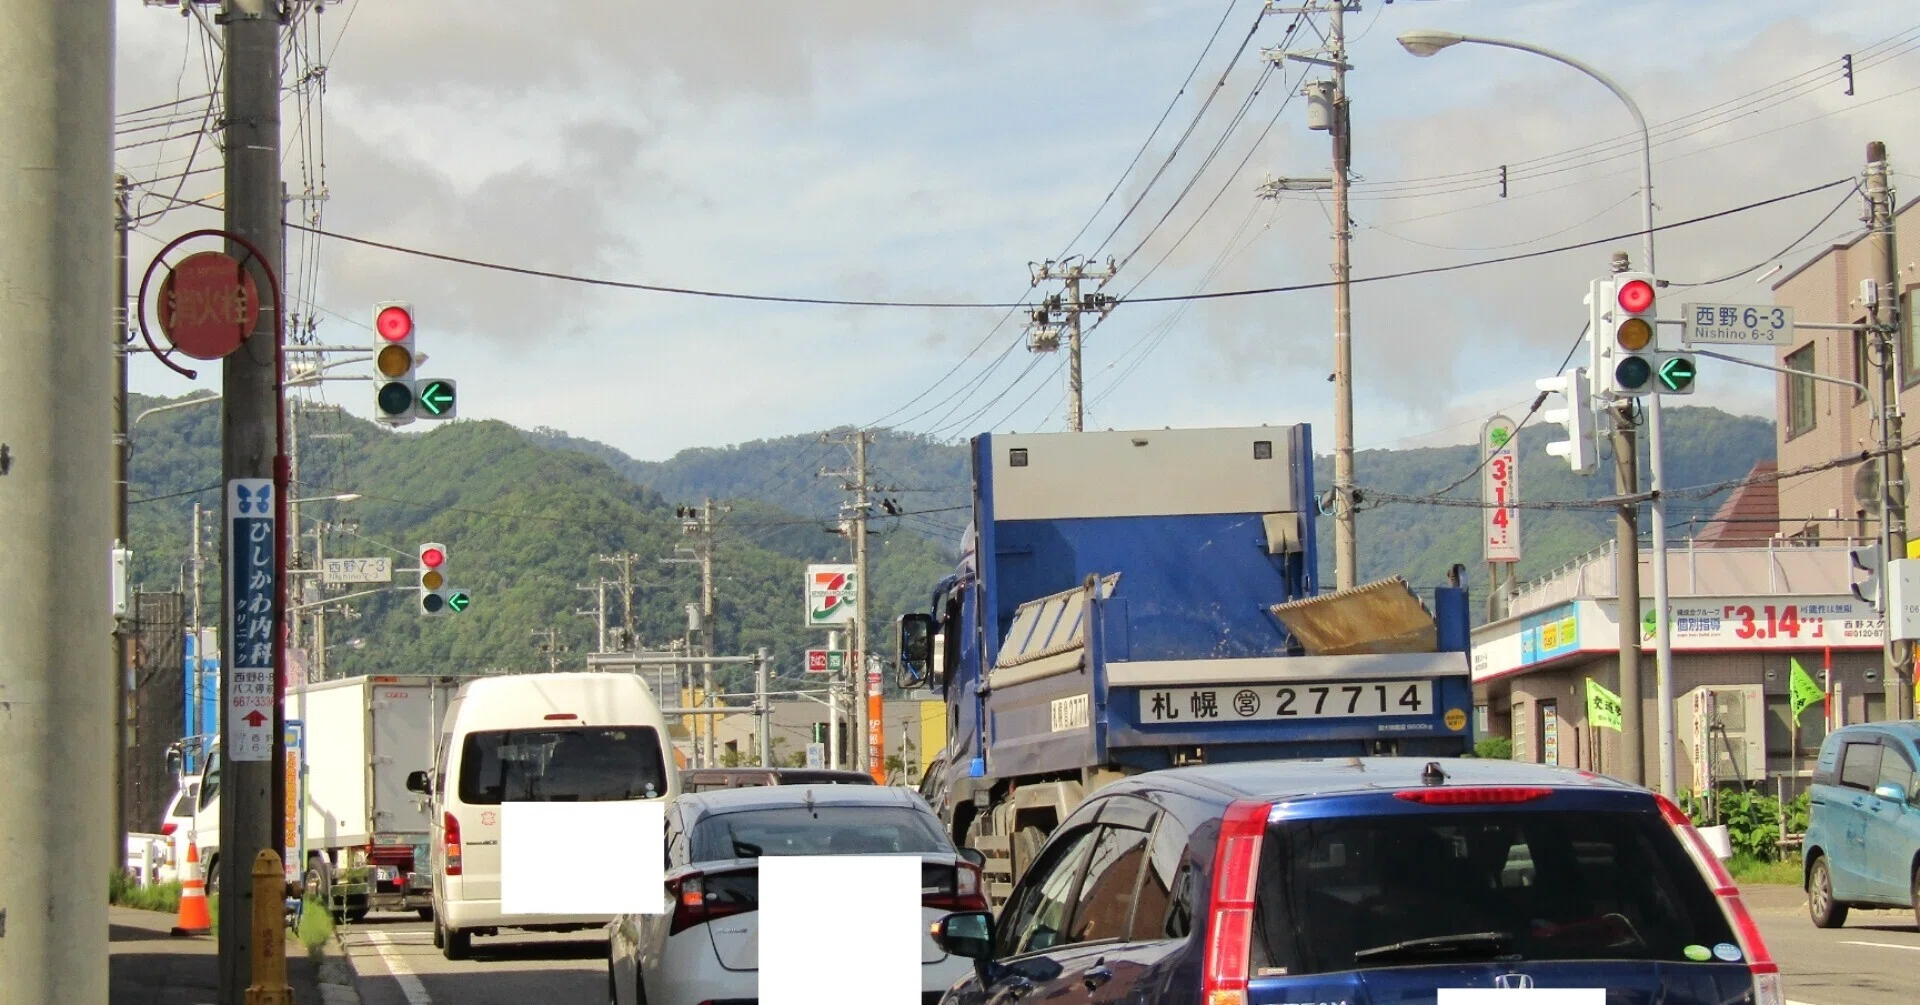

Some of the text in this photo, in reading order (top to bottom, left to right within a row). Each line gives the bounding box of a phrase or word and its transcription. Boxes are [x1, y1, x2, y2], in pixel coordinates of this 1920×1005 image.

[168, 285, 249, 328] 消火栓
[1696, 306, 1785, 330] 西野6-3
[1695, 327, 1774, 341] Nishino 6-3
[329, 559, 385, 573] 西野7-3
[249, 522, 272, 666] ひしかわ内科
[235, 599, 248, 664] クリニック
[1677, 618, 1721, 632] 個別指導
